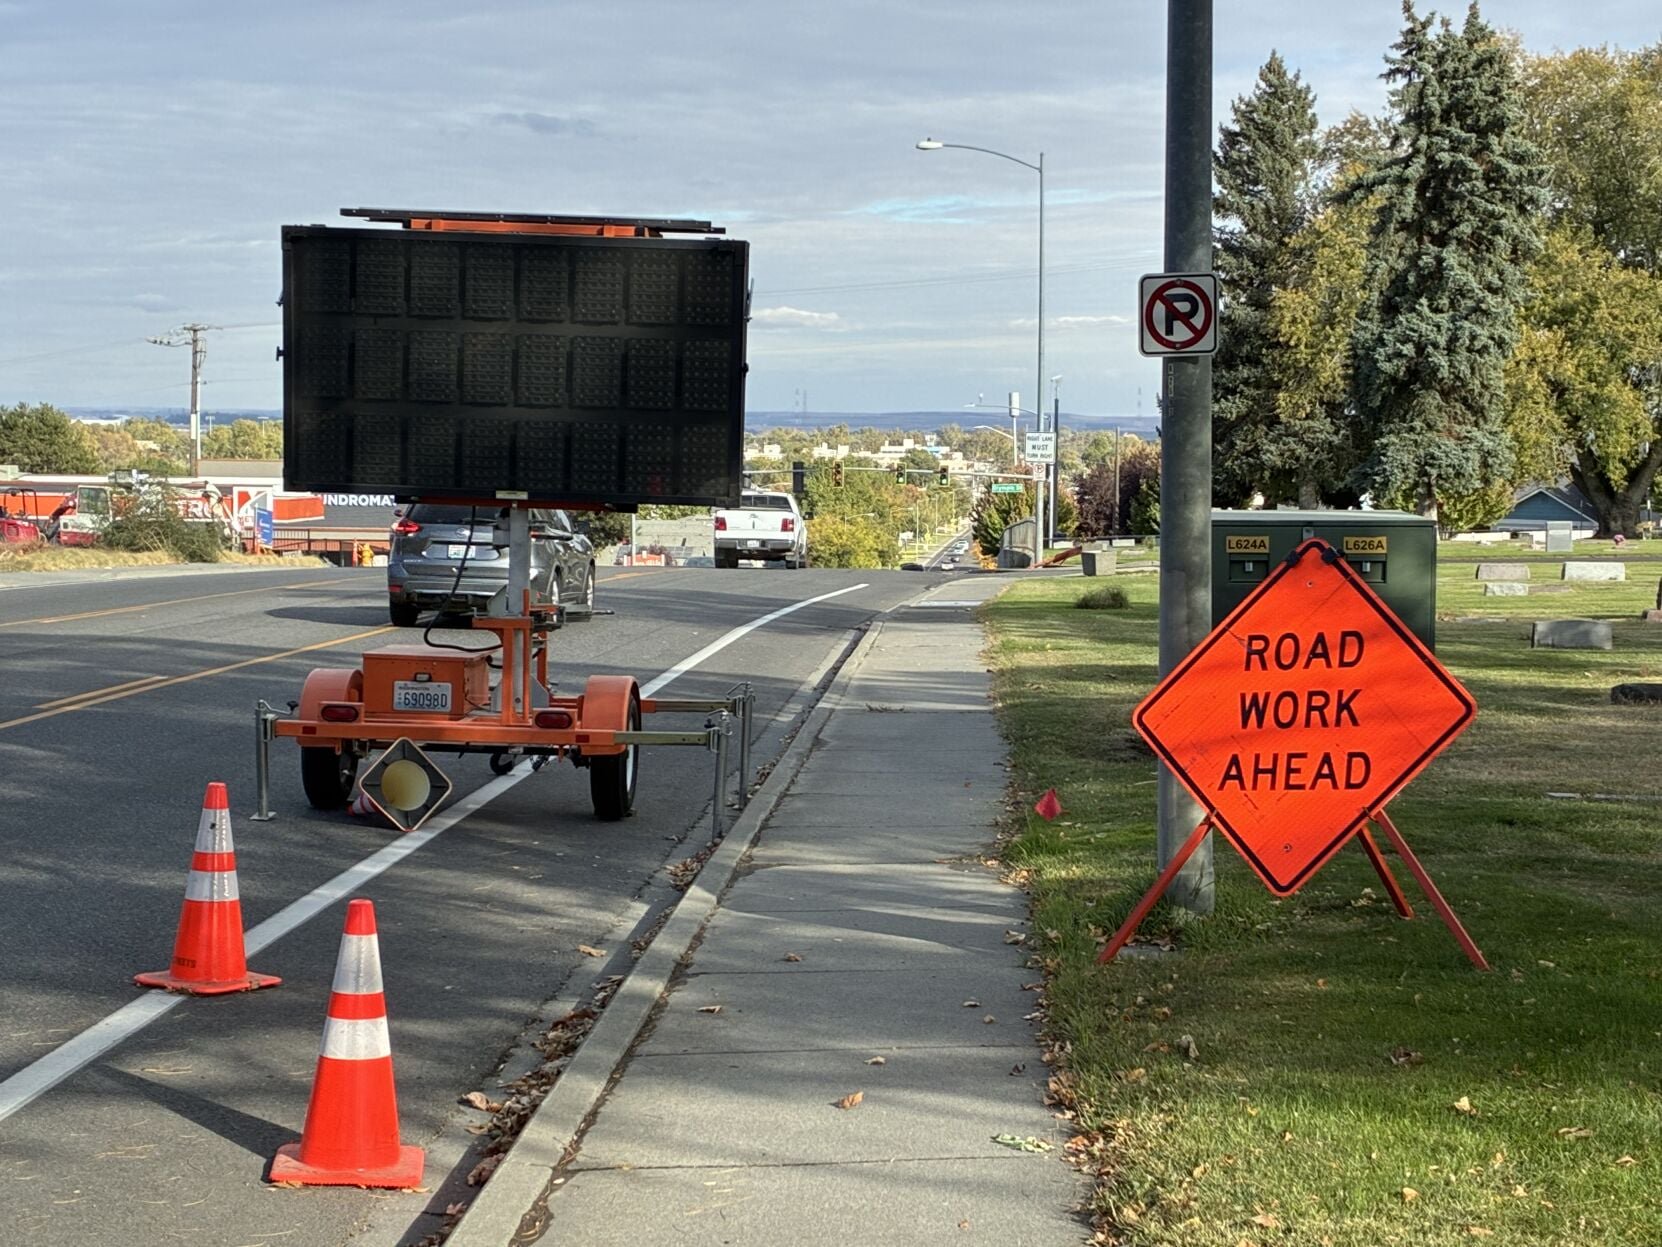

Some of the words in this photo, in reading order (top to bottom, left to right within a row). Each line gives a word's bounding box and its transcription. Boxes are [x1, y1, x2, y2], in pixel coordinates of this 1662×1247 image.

[1227, 538, 1268, 551] L624A
[1345, 538, 1386, 552] L626A
[1243, 629, 1365, 672] ROAD
[1239, 689, 1363, 730] WORK
[1217, 751, 1372, 792] AHEAD
